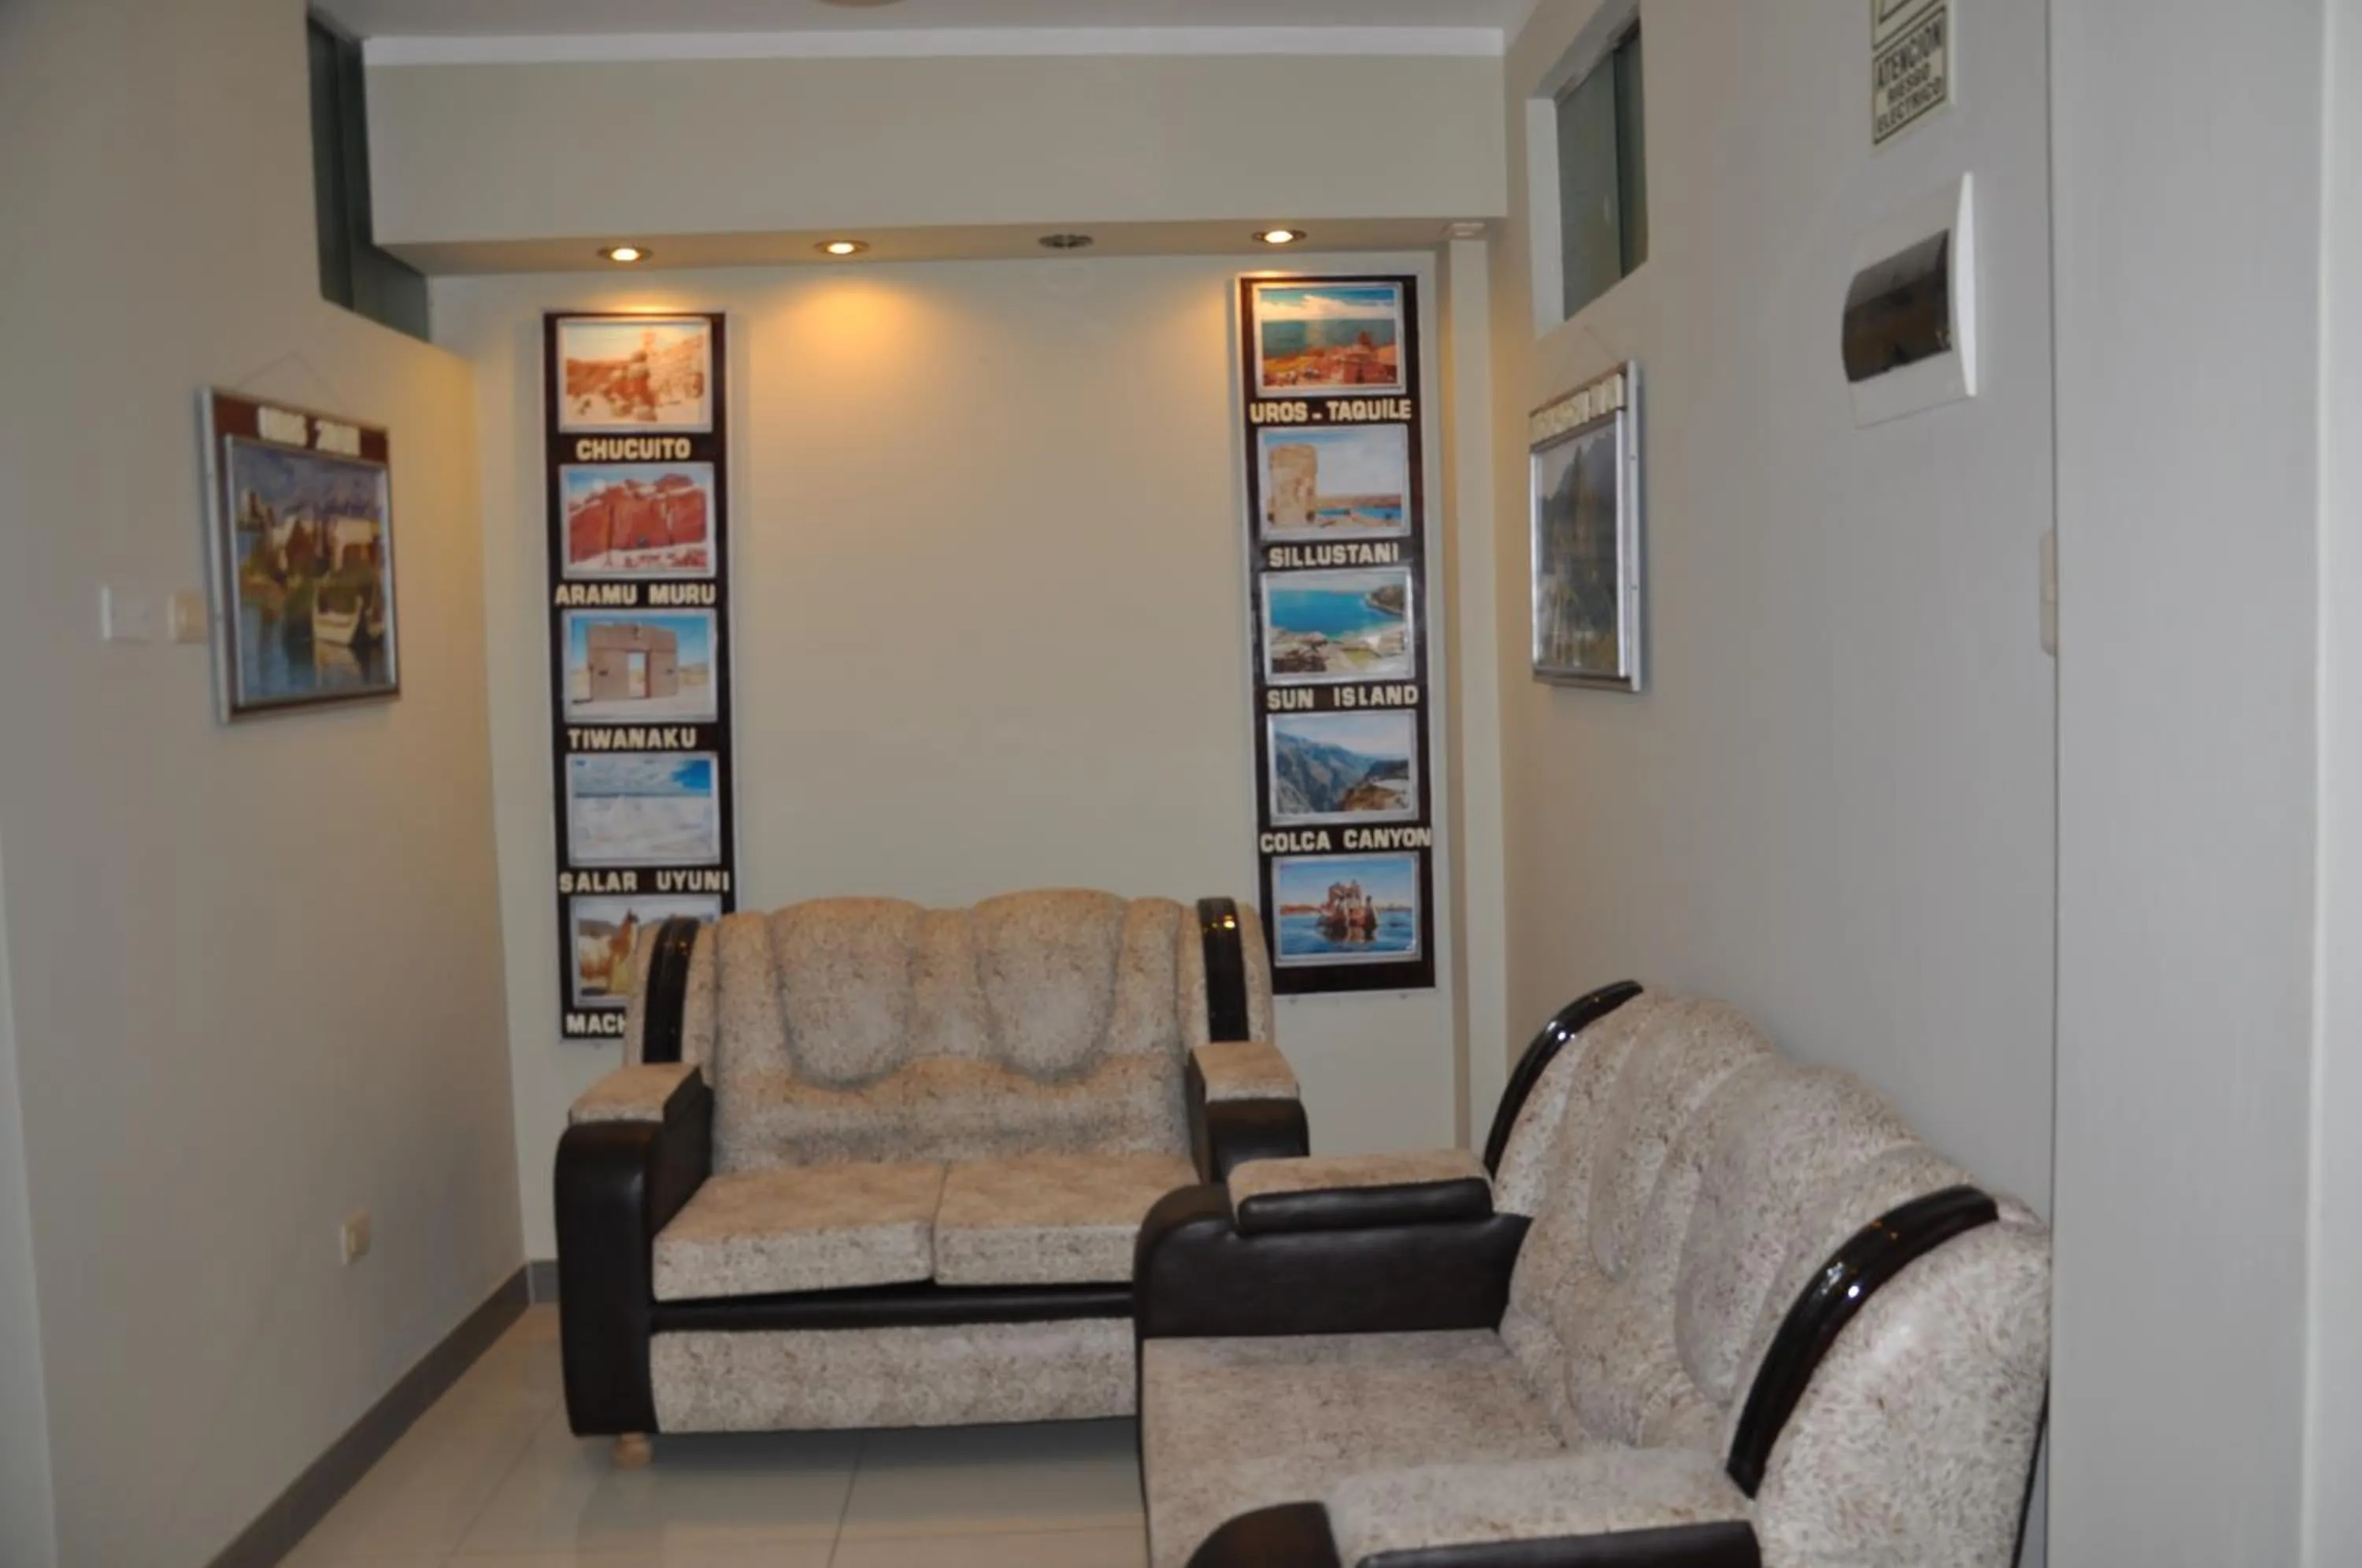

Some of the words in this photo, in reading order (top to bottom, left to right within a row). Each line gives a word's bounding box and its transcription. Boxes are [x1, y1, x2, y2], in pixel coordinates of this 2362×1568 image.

[1249, 402, 1308, 423] UROS
[1326, 398, 1412, 421] TAQUILE
[576, 437, 691, 460] CHUCUITO
[1269, 543, 1399, 568] SILLUSTANI
[555, 584, 638, 605] ARAMU
[649, 584, 716, 605] MURU
[1266, 688, 1315, 709] SUN
[1334, 685, 1420, 707] ISLAND
[568, 727, 697, 749] TIWANAKU
[1261, 830, 1331, 852] COLCA
[1342, 827, 1432, 849] CANYON
[559, 871, 637, 893] SALAR
[656, 870, 731, 891] UYUNI
